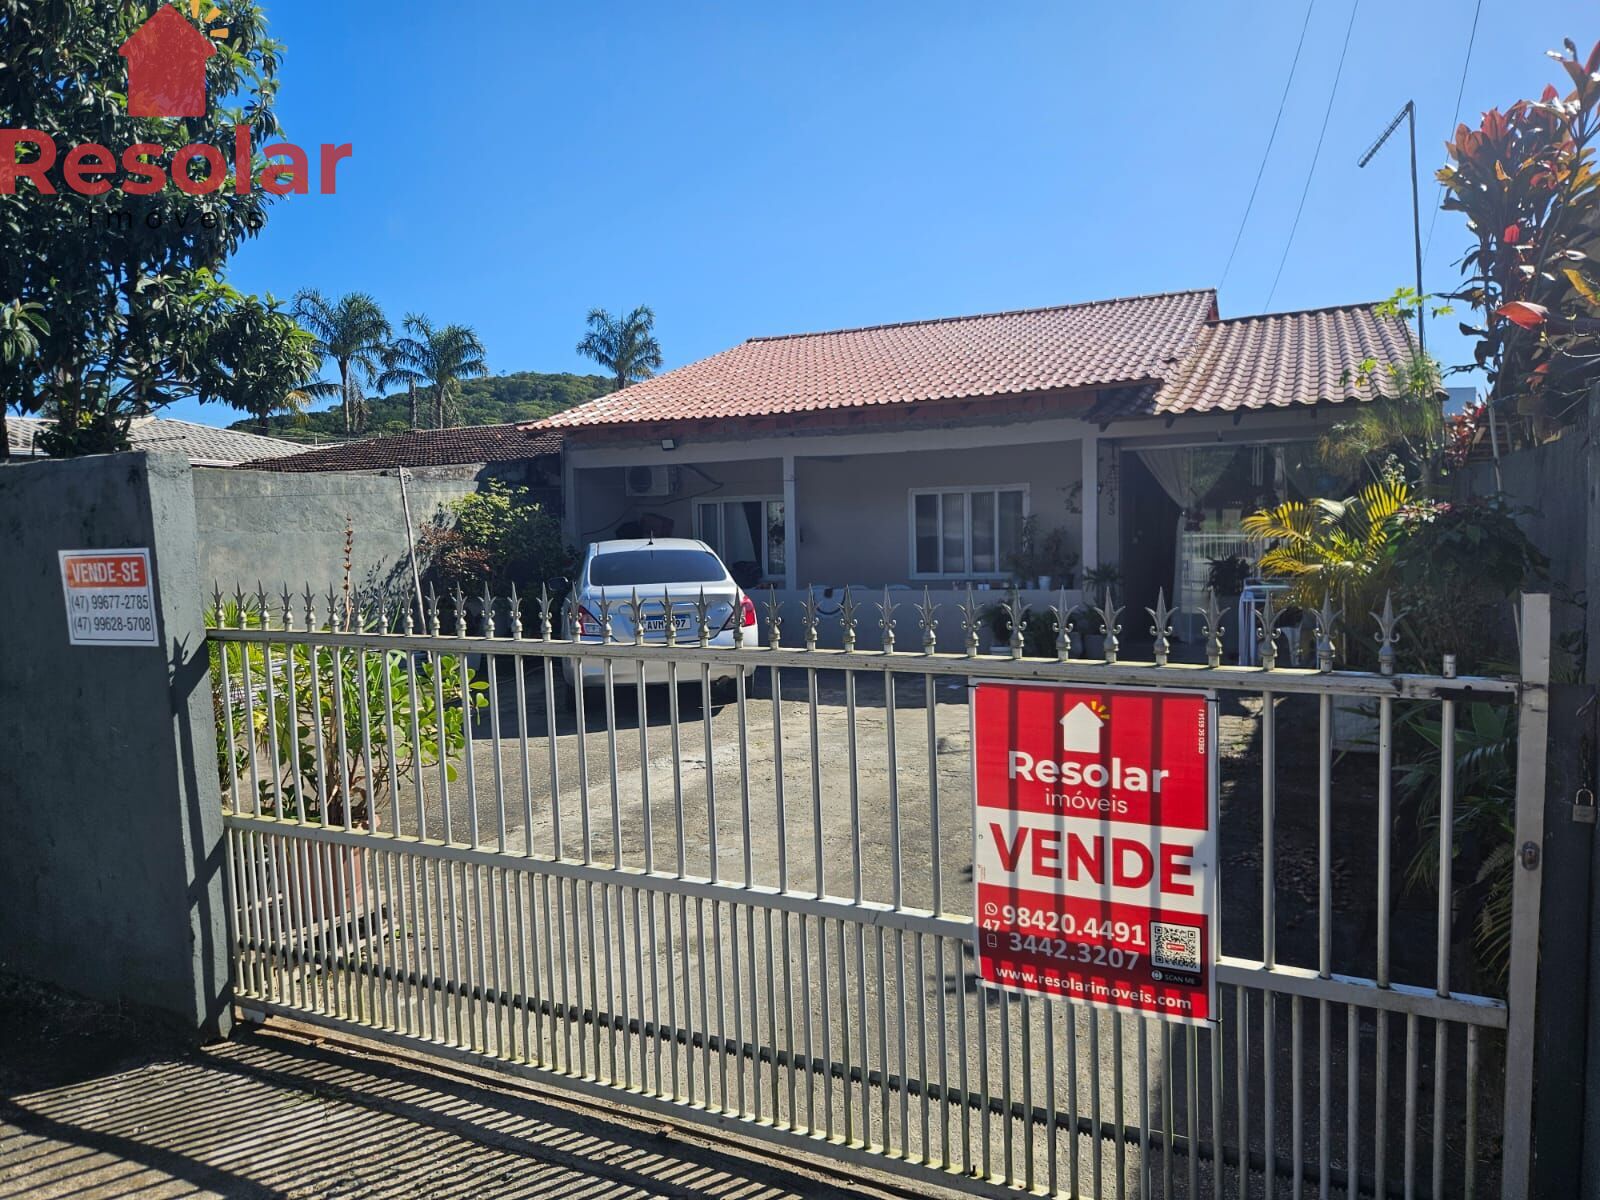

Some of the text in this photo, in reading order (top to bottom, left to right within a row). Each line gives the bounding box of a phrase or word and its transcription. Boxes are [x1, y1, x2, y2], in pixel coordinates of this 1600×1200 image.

[71, 561, 140, 583] VENDE-SE
[71, 594, 149, 613] (47) 99677-2785
[74, 616, 151, 634] (47) 99628-5708
[647, 618, 686, 630] AVM97
[1008, 751, 1169, 793] Resolar
[1045, 788, 1128, 814] imóveis
[989, 822, 1195, 897] VENDE
[983, 919, 1000, 932] 47
[1002, 904, 1146, 947] 98420.4491
[1009, 932, 1139, 970] 3442.3207
[995, 968, 1192, 1010] www.resolarimoveis.com
[1164, 974, 1184, 983] SCAN
